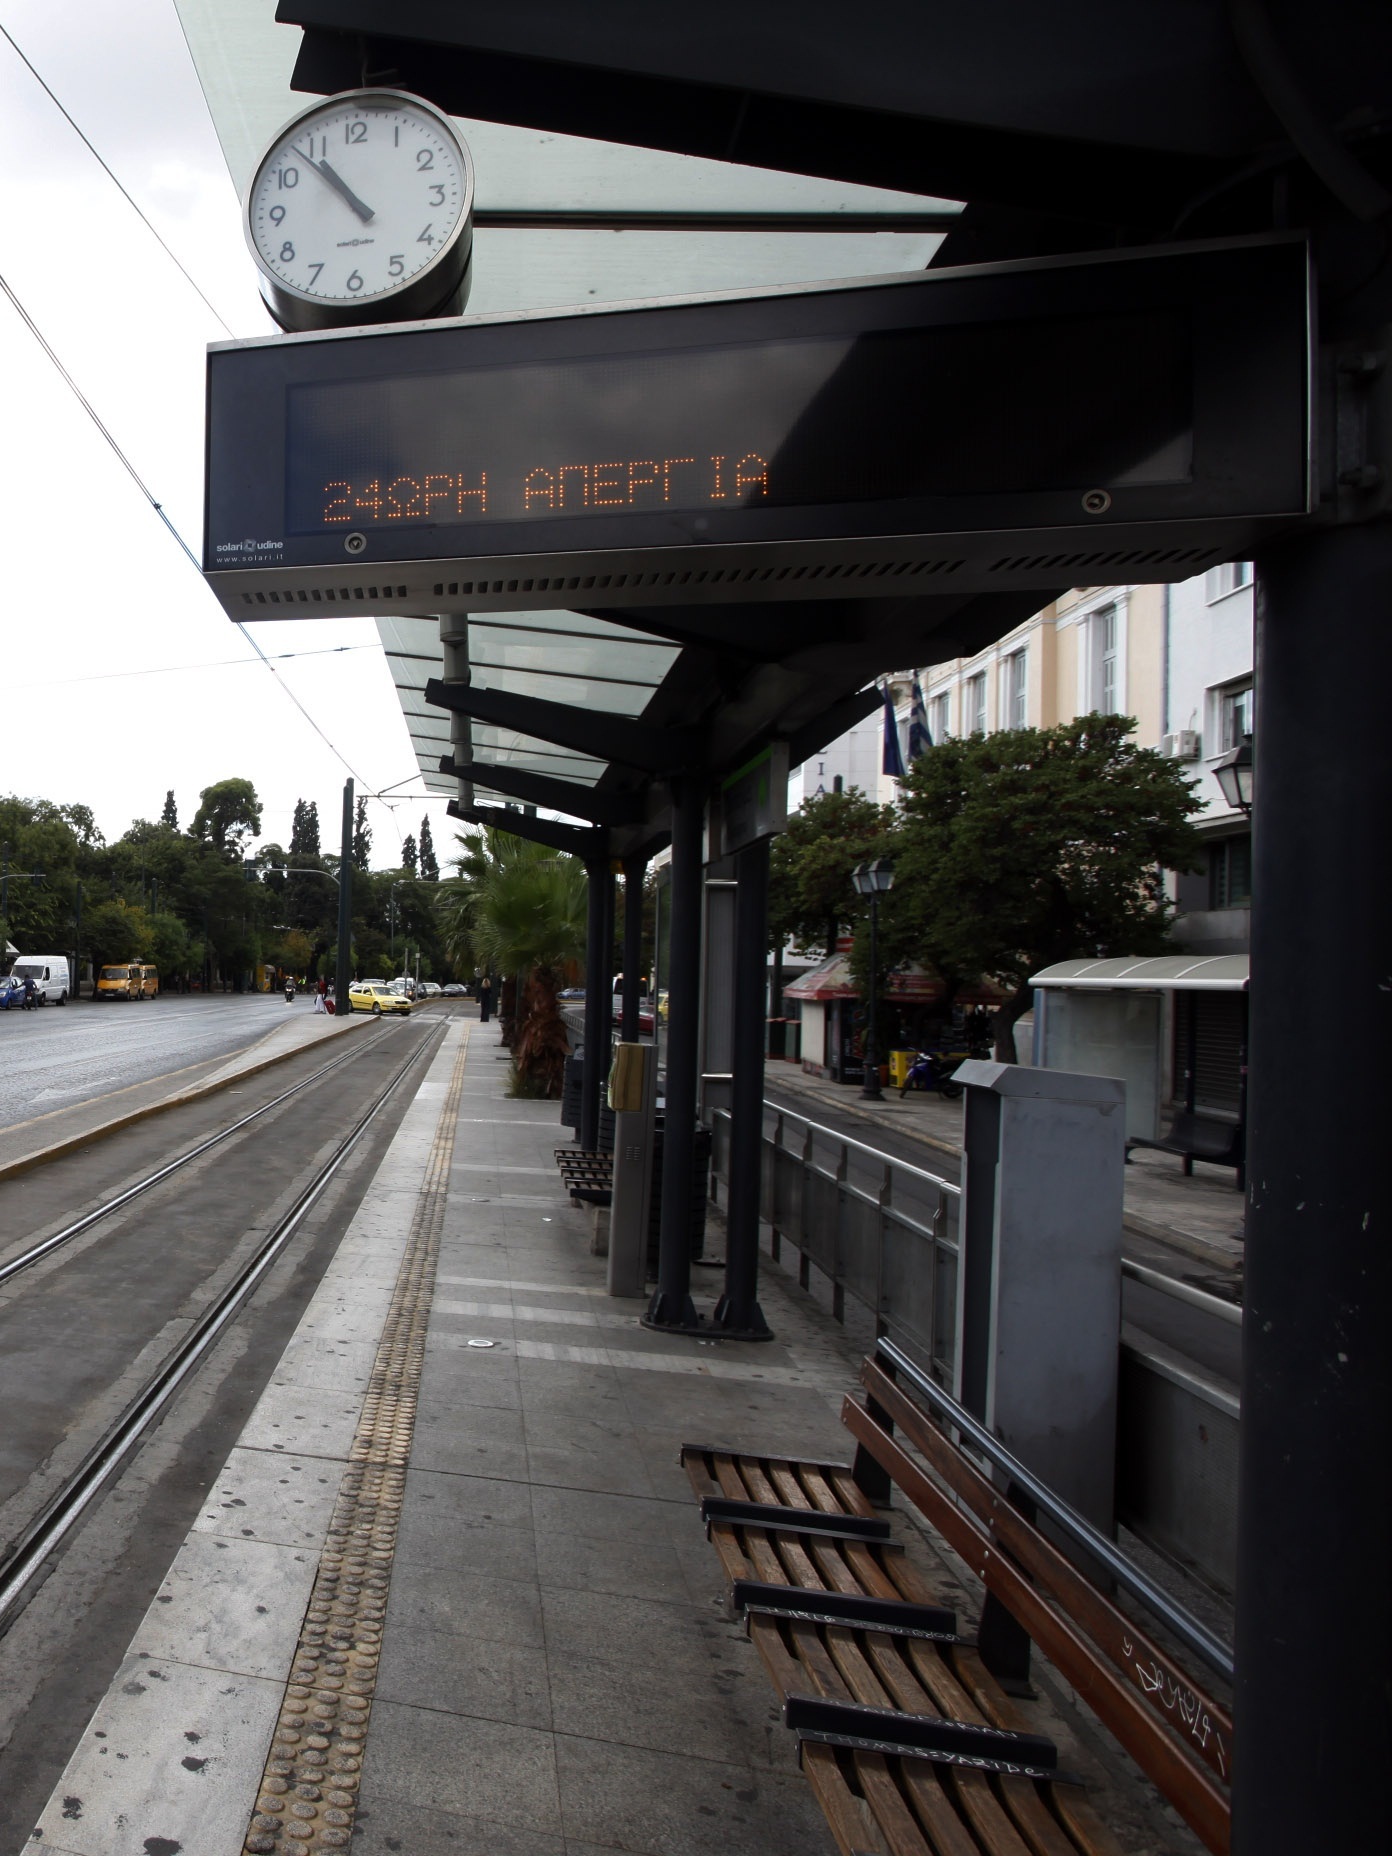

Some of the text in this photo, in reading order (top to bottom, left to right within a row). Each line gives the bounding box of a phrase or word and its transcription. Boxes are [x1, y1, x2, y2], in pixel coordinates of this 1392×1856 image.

[345, 121, 368, 145] 12
[394, 125, 399, 148] 1
[309, 135, 327, 159] 11
[416, 149, 434, 172] 2
[278, 167, 299, 190] 10
[428, 183, 446, 207] 3
[269, 205, 286, 227] 9
[416, 223, 434, 246] 4
[279, 241, 295, 263] 8
[308, 263, 325, 286] 7
[387, 254, 405, 277] 5
[346, 269, 364, 292] 6
[525, 453, 768, 510] ΑΠΕΡΓΙΑ
[216, 540, 284, 552] solari udine
[216, 553, 284, 563] www.solari.it
